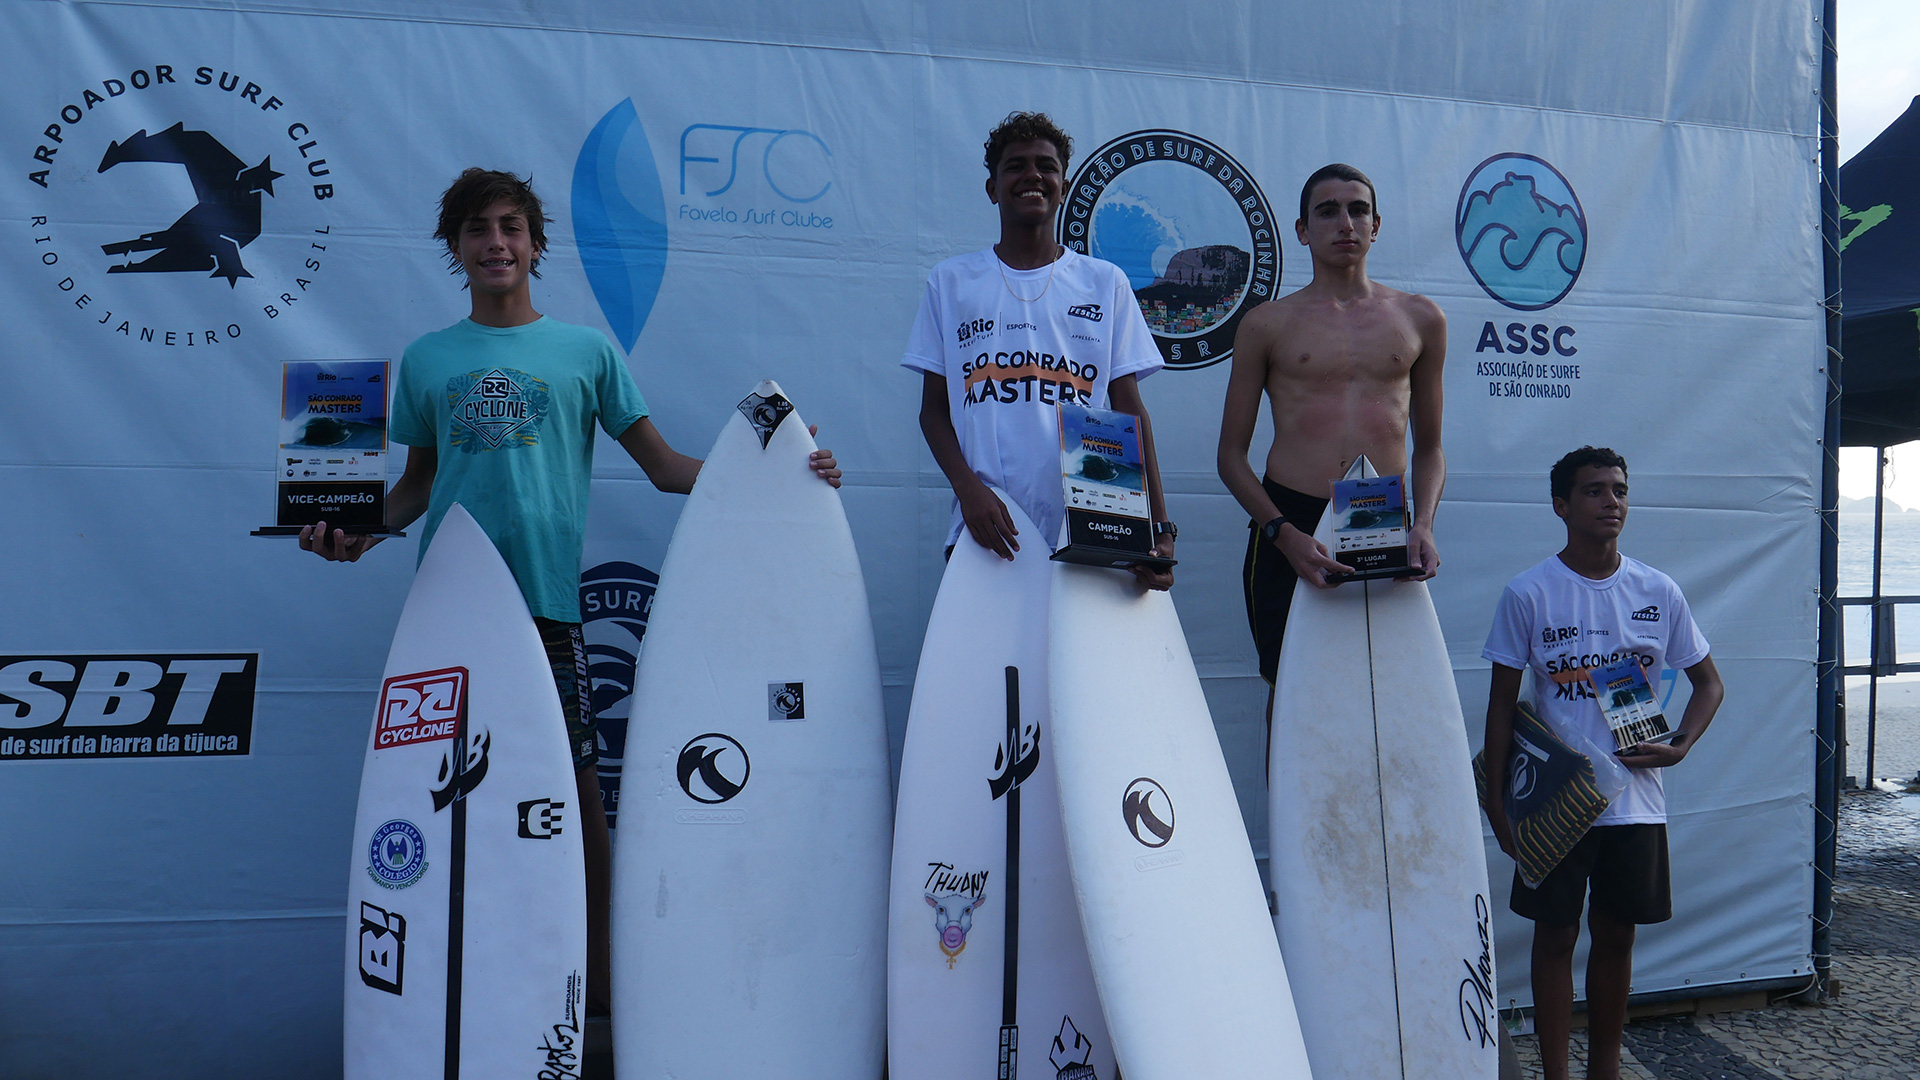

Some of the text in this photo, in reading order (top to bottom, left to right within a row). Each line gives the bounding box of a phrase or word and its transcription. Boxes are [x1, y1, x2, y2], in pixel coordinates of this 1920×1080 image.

[29, 64, 334, 201] ARPOADOR SURF CLUB
[679, 204, 833, 229] Favela Surf Clube
[1130, 140, 1157, 161] DE
[1163, 140, 1216, 169] SURF
[1218, 166, 1245, 195] DA
[1241, 195, 1274, 297] ROCINHA
[98, 310, 242, 346] JANEIRO
[263, 224, 330, 319] BRASIL
[1069, 306, 1102, 320] FESERJ
[972, 318, 995, 336] Rio
[1006, 322, 1038, 331] ESPORTES
[1475, 321, 1578, 357] ASSC
[995, 349, 1098, 382] CONRADO
[1477, 361, 1581, 379] ASSOCIAÇÃO DE SURFE
[308, 393, 363, 402] SÃO CONRADO
[1489, 381, 1571, 399] DE SÃO CONRADO
[308, 404, 362, 414] MASTERS
[465, 400, 527, 420] CYCLONE
[1081, 433, 1123, 446] SÃO CONRADO
[1083, 443, 1124, 456] MASTERS
[287, 492, 375, 504] VICE-CAMPEÃO
[1350, 501, 1387, 509] MASTERS
[1088, 521, 1132, 536] CAMPEÃO
[1557, 626, 1578, 640] Rio
[1545, 653, 1578, 675] SÃO
[571, 639, 591, 726] CYCLONE
[379, 721, 455, 745] CYCLONE
[1, 733, 238, 755] de surf da barra da tijuca
[383, 824, 418, 839] Georges
[366, 861, 430, 890] FORMANDO VENCEDORES
[379, 862, 418, 880] COLÉGIO
